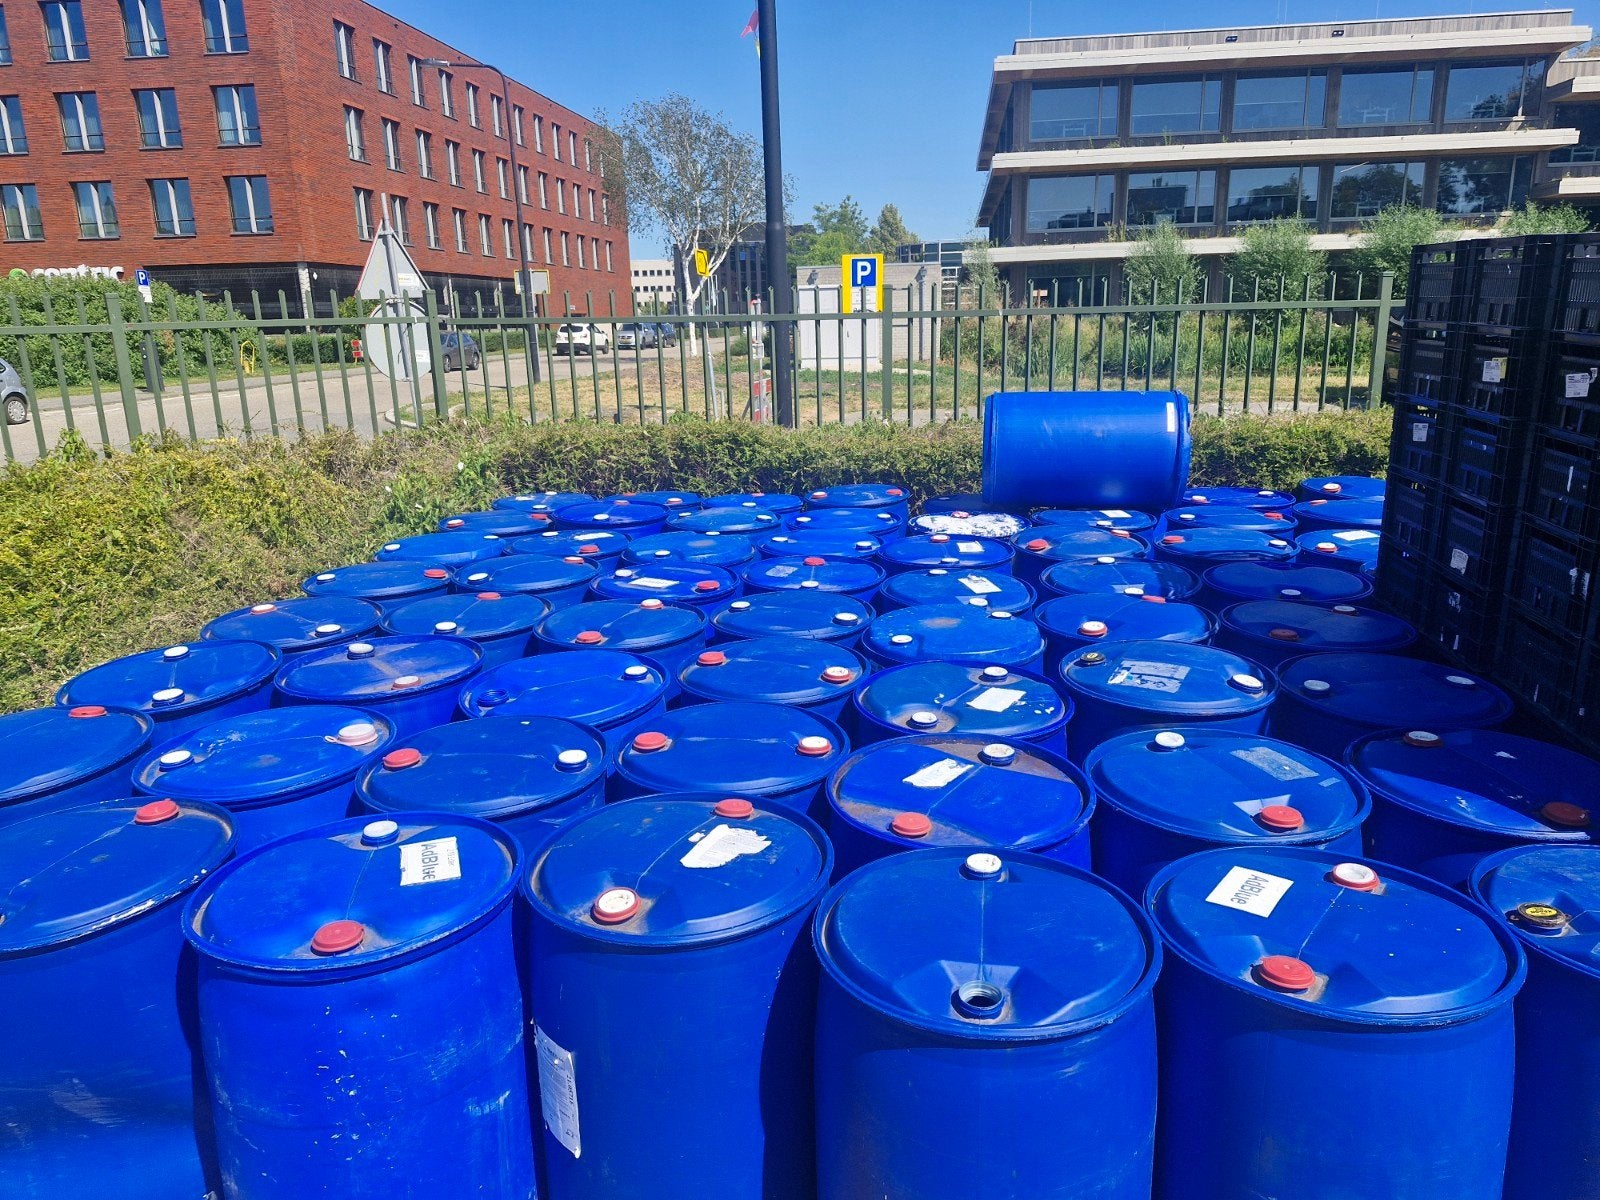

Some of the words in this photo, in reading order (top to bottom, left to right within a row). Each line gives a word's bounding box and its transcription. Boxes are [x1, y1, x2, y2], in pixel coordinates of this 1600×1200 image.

[139, 271, 146, 284] P
[857, 261, 871, 285] P
[421, 843, 439, 881] AdBlue
[1230, 874, 1269, 905] AdBlue
